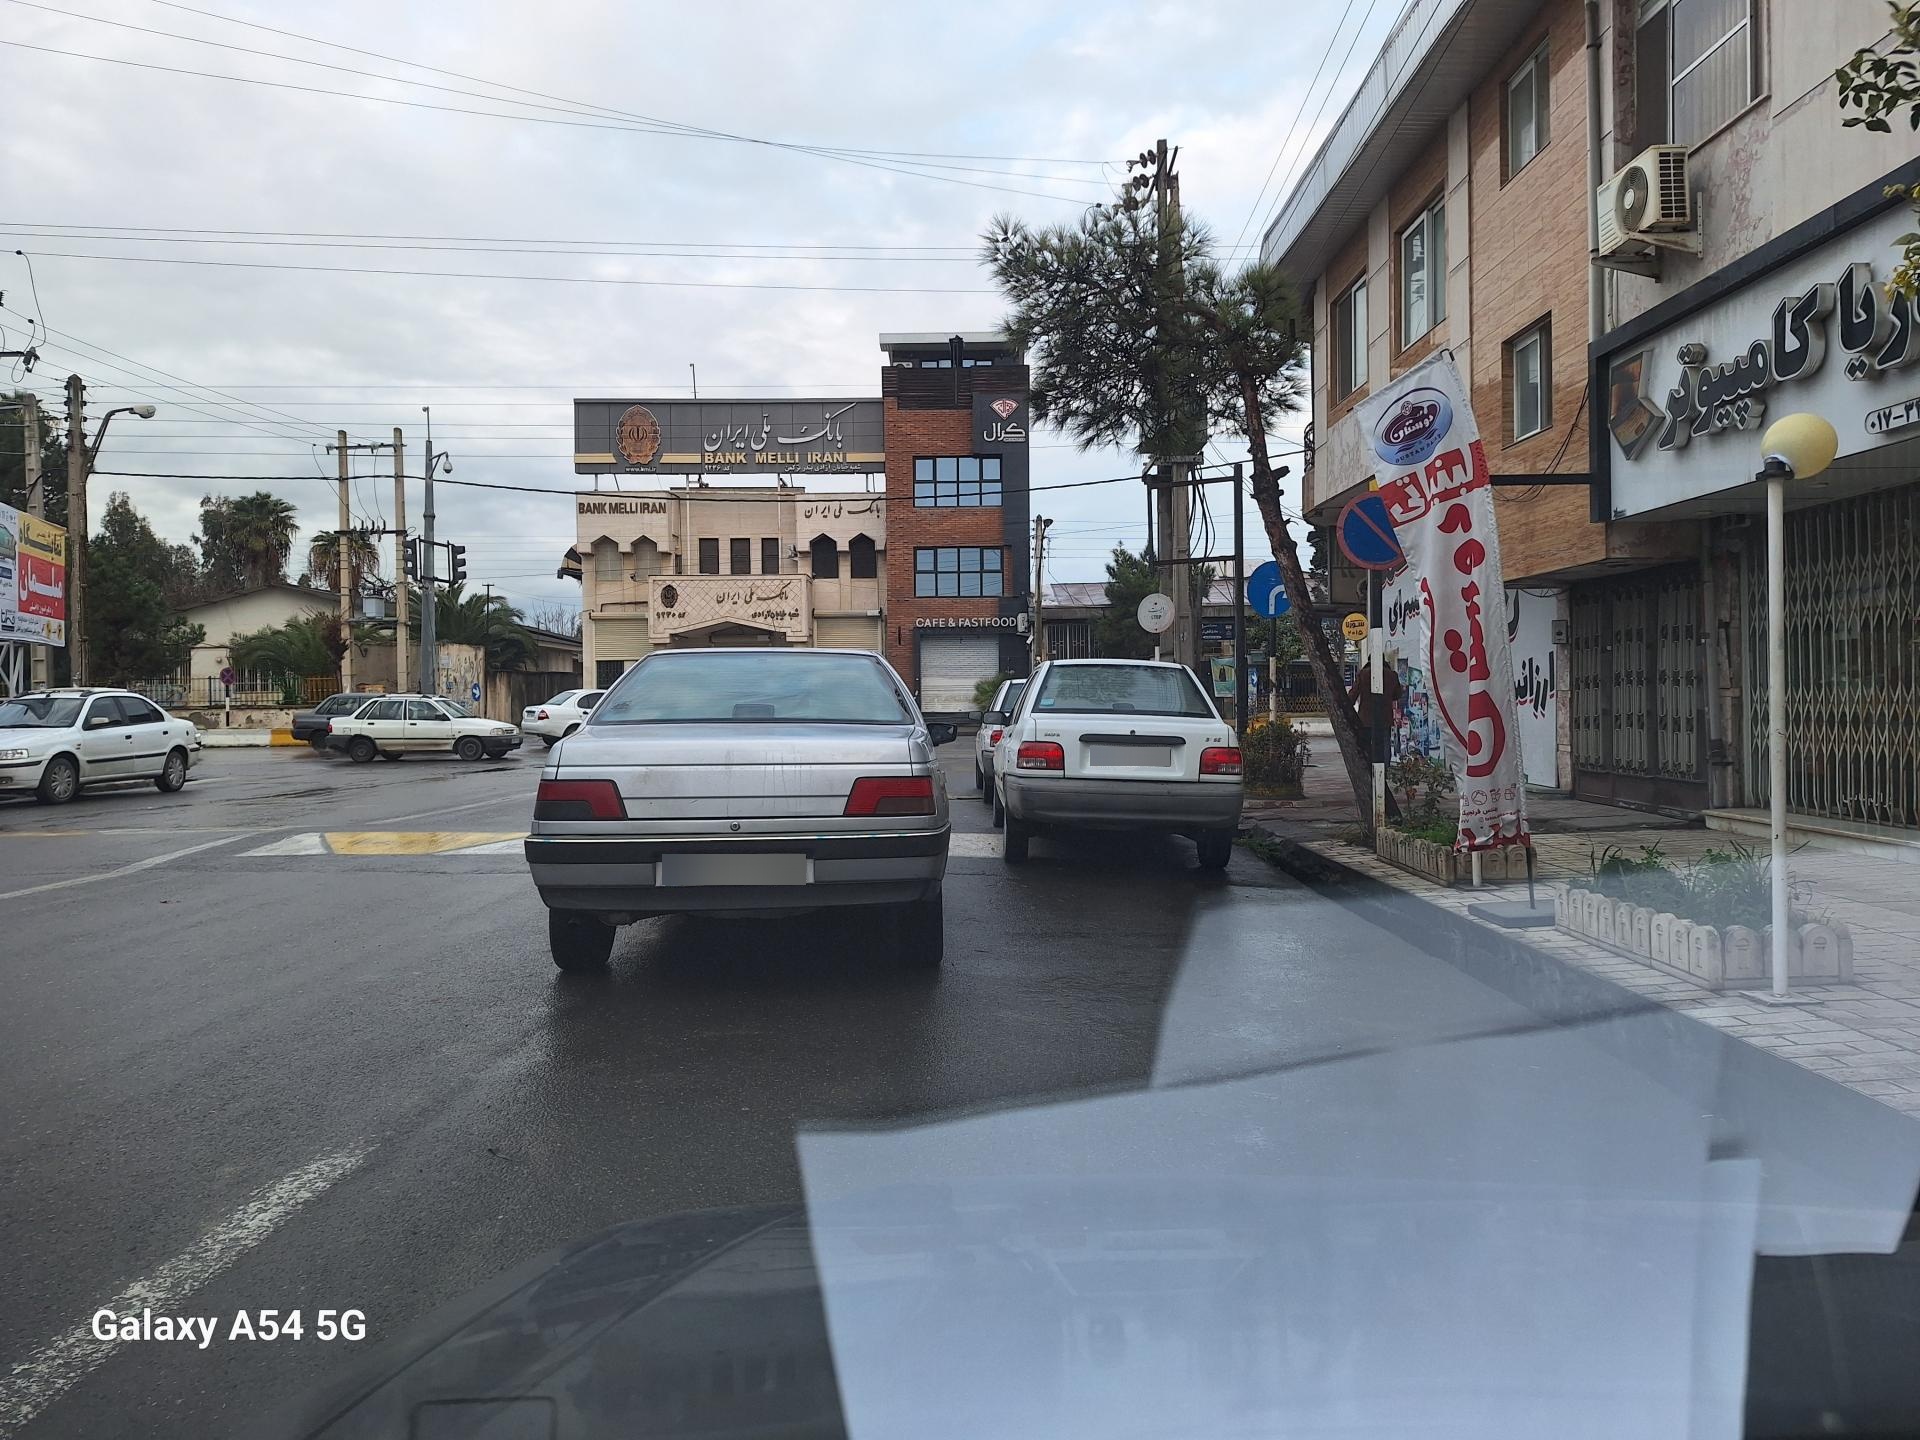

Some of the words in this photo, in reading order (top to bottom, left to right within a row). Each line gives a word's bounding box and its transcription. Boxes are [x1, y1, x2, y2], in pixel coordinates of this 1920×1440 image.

[1657, 283, 1836, 451] کامپیوتر
[777, 402, 857, 449] بانک
[983, 422, 1026, 442] کرال
[703, 422, 749, 452] ایران
[704, 452, 747, 464] BANK
[755, 452, 799, 464] MELLI
[807, 451, 844, 463] IRAN
[578, 502, 607, 514] BANK
[608, 502, 638, 514] MELLI
[639, 502, 667, 514] IRAN
[804, 505, 830, 519] ایران
[833, 500, 843, 518] ملی
[847, 495, 882, 519] بانک
[19, 558, 63, 607] مبلمان
[756, 580, 792, 601] بانک
[716, 591, 740, 605] ایران
[915, 618, 946, 628] CAFE
[947, 618, 956, 627] &
[958, 617, 1017, 627] FASTFOOD
